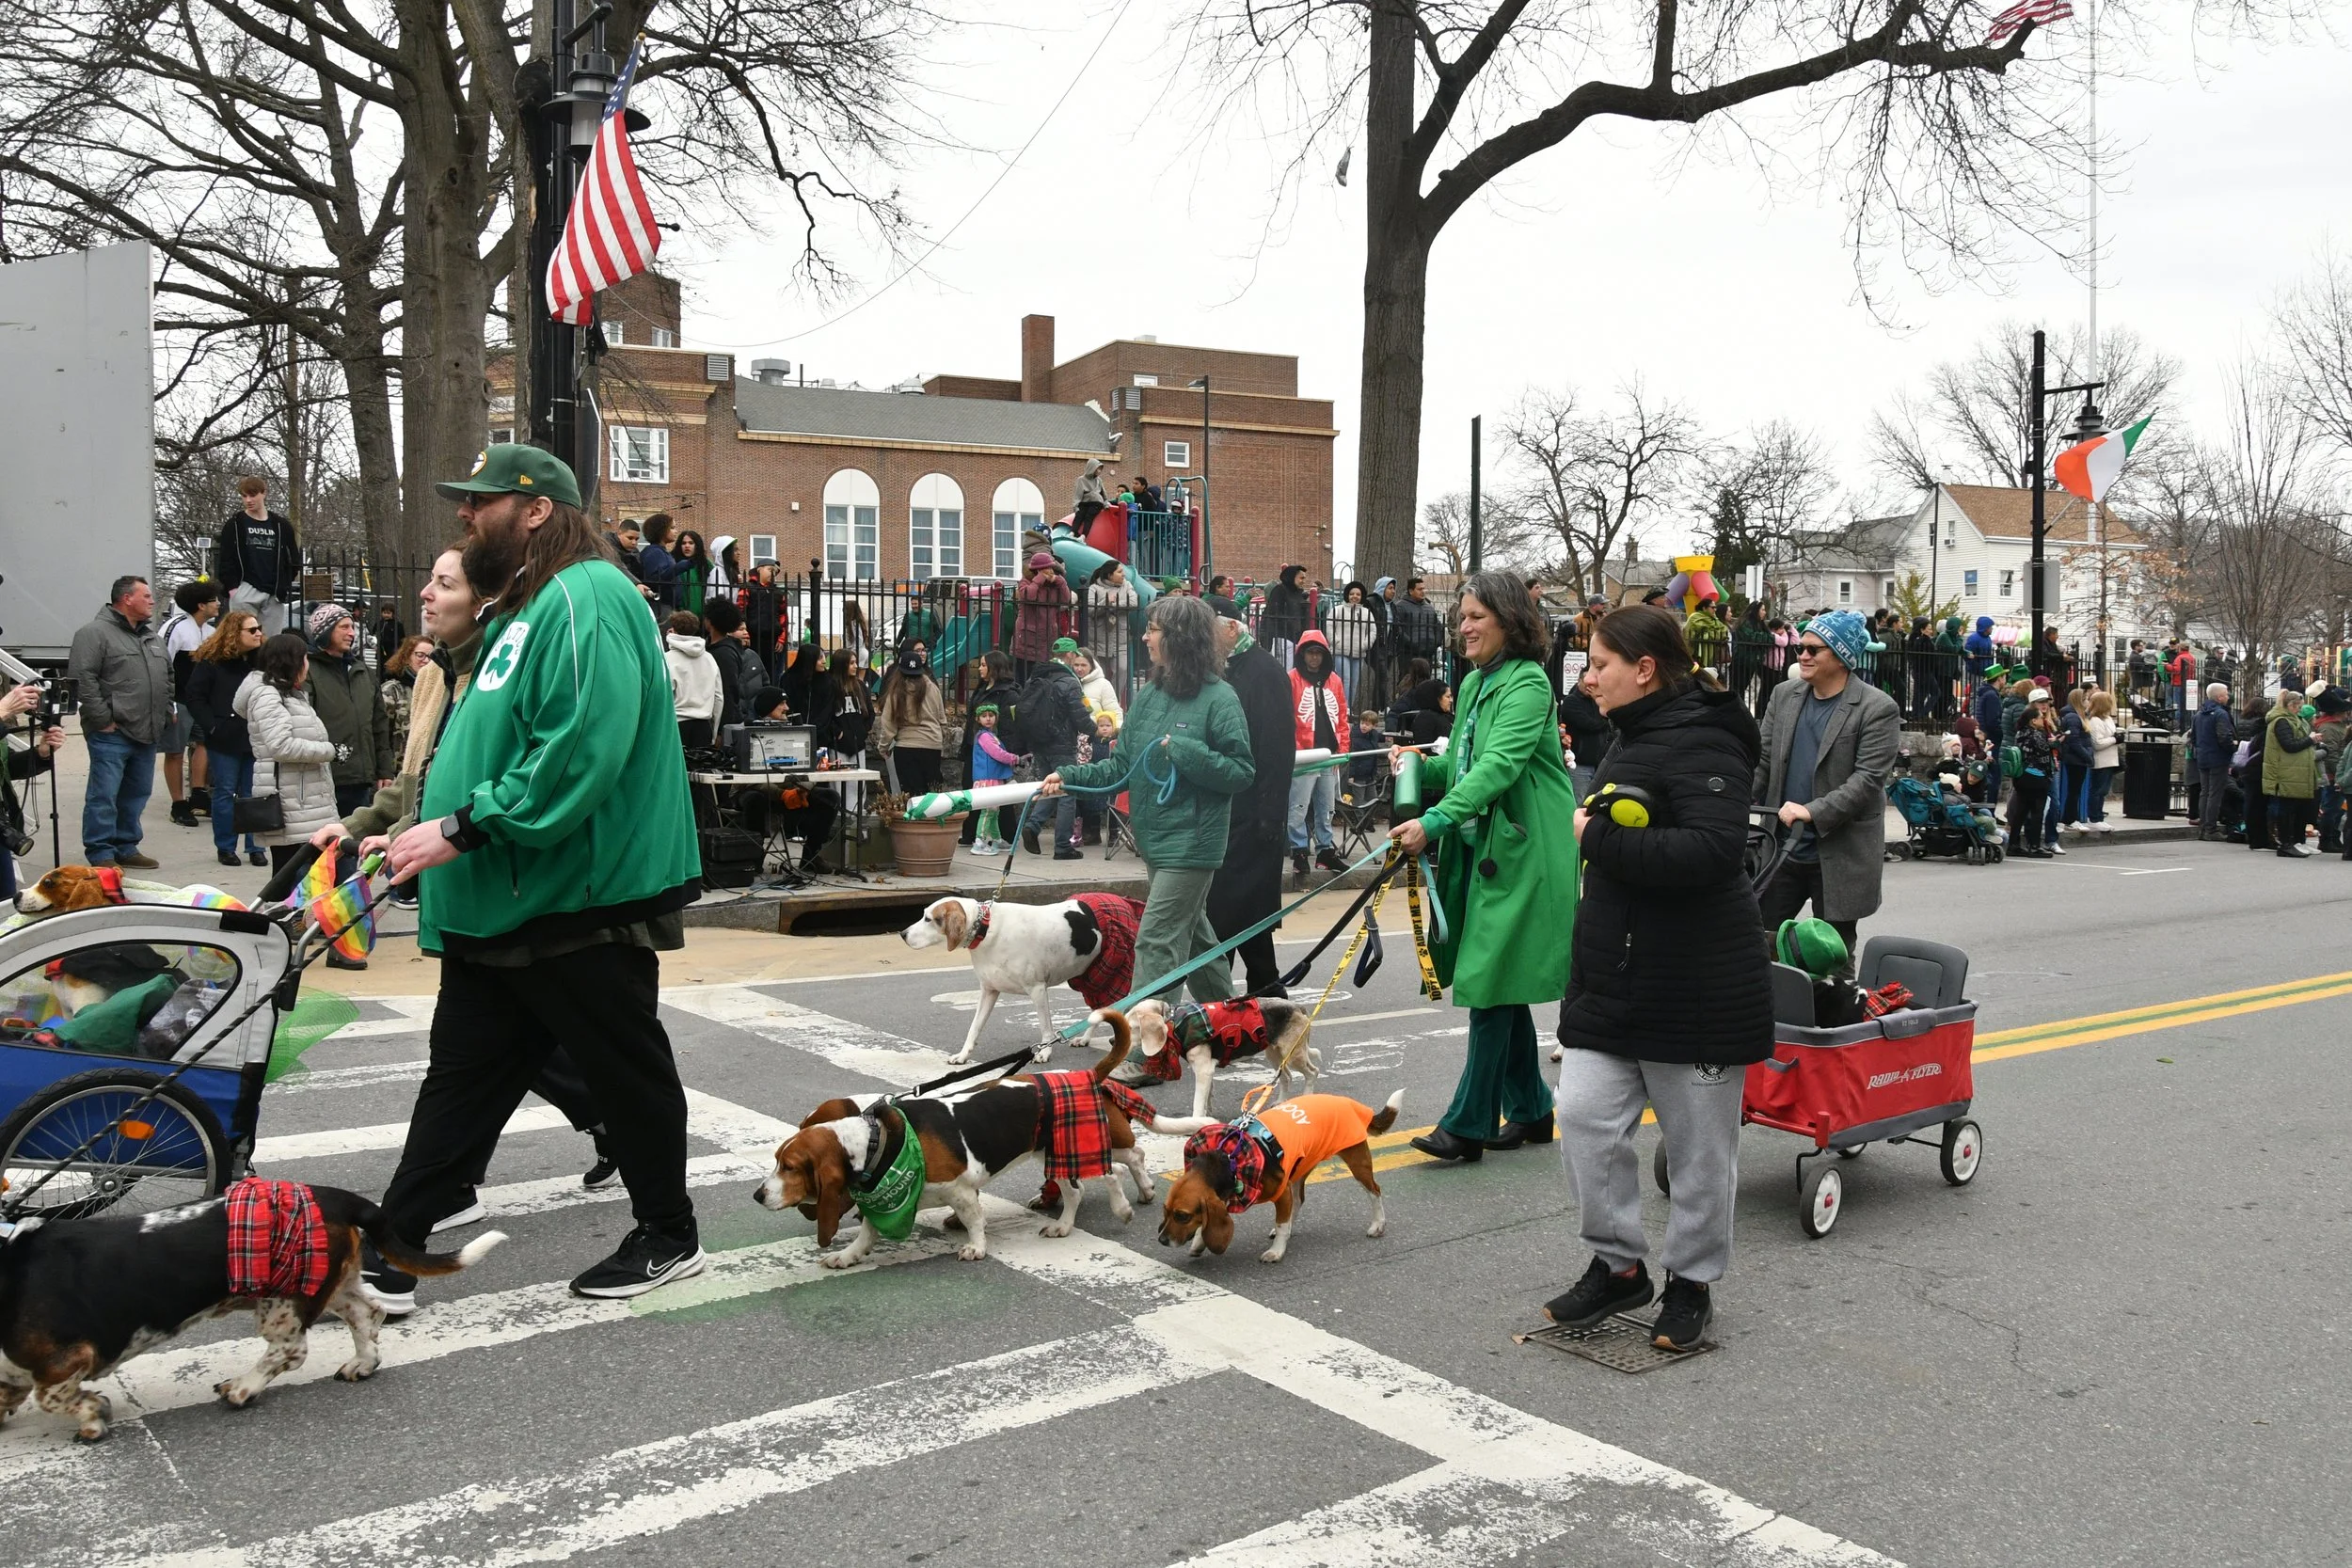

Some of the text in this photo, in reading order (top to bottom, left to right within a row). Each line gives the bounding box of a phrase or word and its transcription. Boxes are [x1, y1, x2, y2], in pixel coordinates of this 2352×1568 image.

[1411, 904, 1425, 947] ADOPT ME
[1429, 967, 1437, 979] ME
[1911, 1064, 1942, 1080] FLYER
[882, 1170, 915, 1200] HOUND
